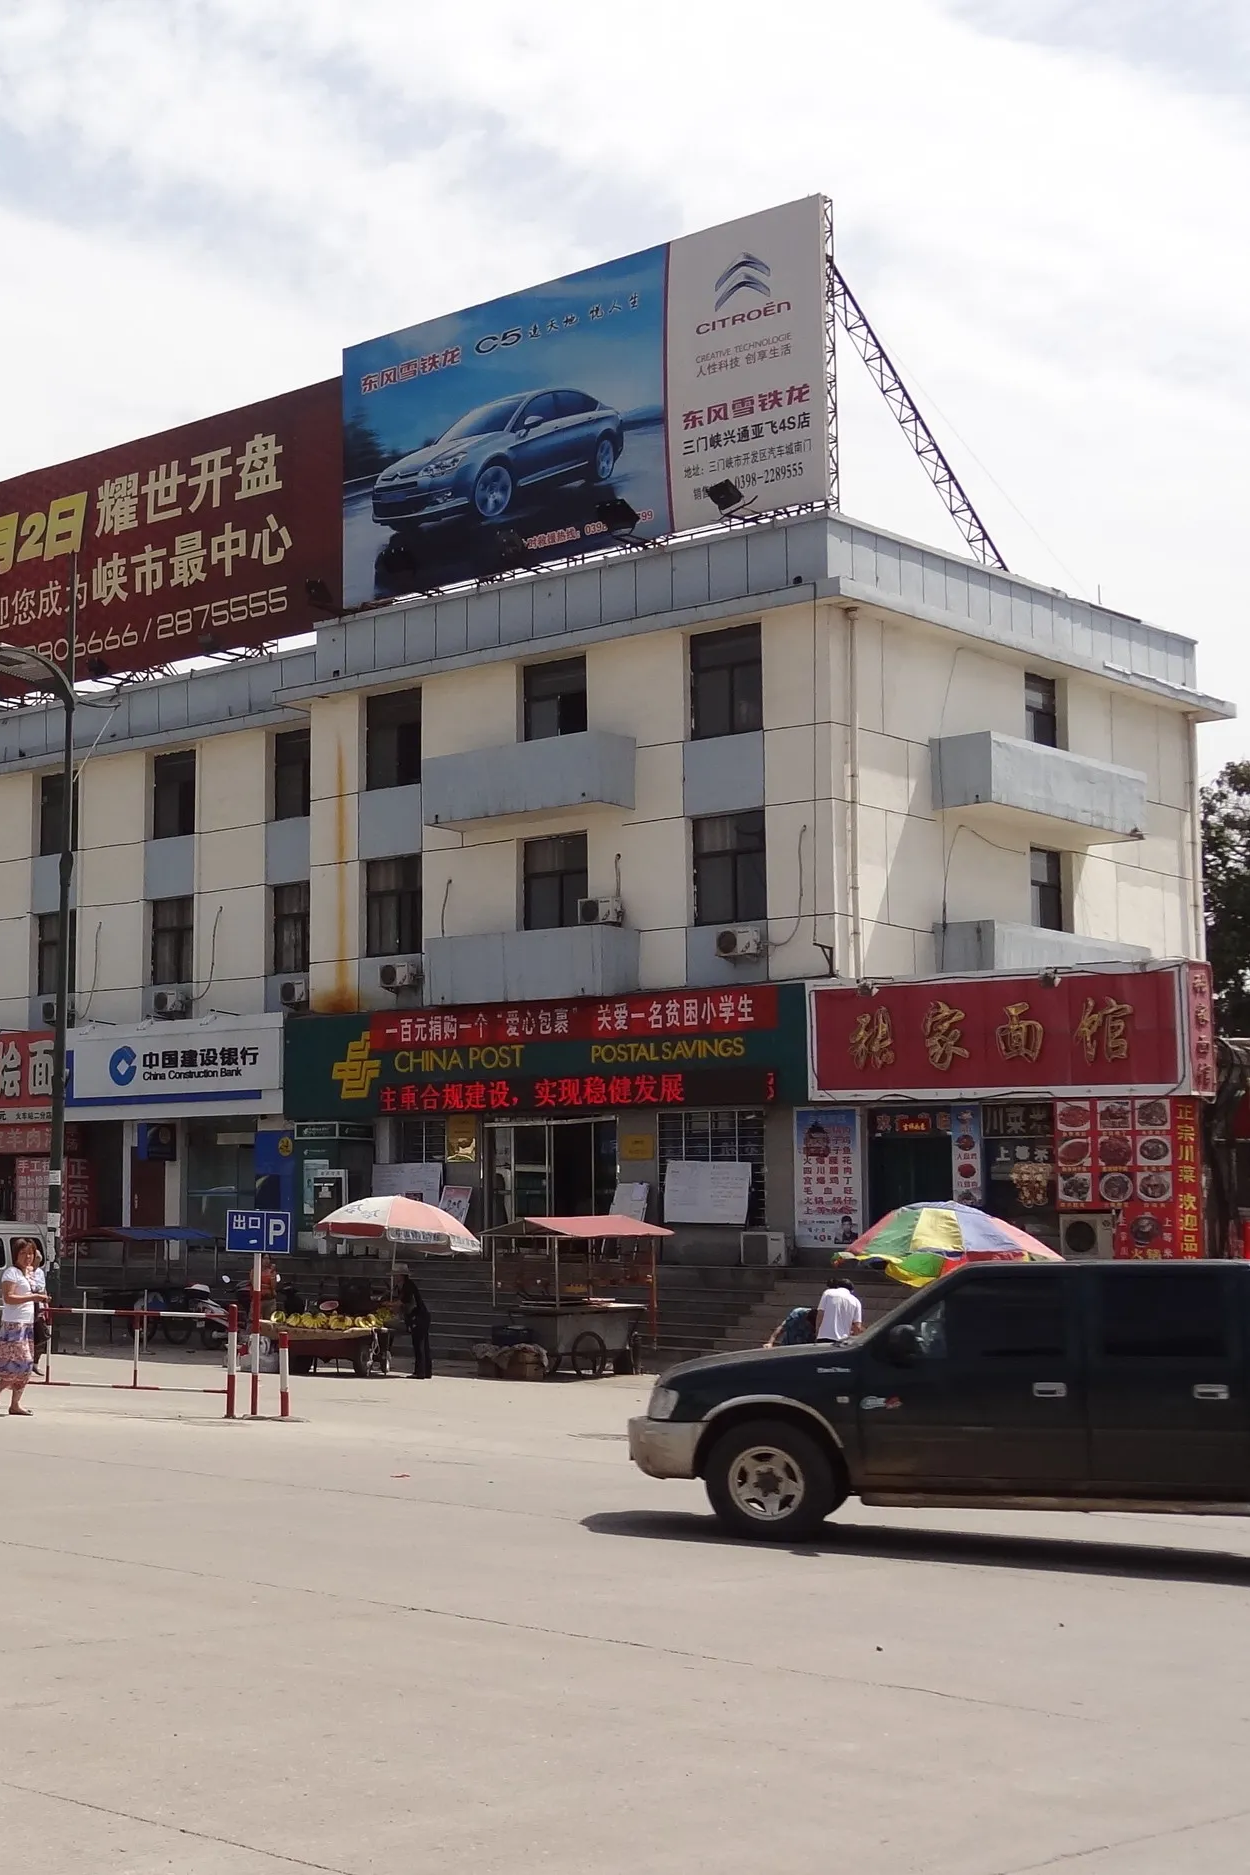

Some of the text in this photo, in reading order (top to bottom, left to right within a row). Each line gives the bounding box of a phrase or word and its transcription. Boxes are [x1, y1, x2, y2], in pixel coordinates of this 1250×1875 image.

[361, 347, 461, 395] 东风雪铁龙
[474, 327, 522, 355] C5
[695, 332, 792, 364] CREATIVE TECHNOLOGIE
[696, 343, 792, 378] 人性科技 创享生活
[682, 383, 810, 430] 东风雪铁龙
[682, 412, 811, 456] 三门峡兴通亚飞4S店
[96, 433, 284, 539] 耀世开盘
[597, 993, 755, 1032] 关爱一名贫困小学生
[142, 1046, 259, 1069] 中国建设银行
[394, 1036, 746, 1073] CHINA POST POSTAL SAVINGS
[142, 1066, 243, 1081] China Construction Bank
[1176, 1103, 1197, 1183] 正宗川菜
[233, 1214, 261, 1230] 出口
[269, 1218, 286, 1246] P
